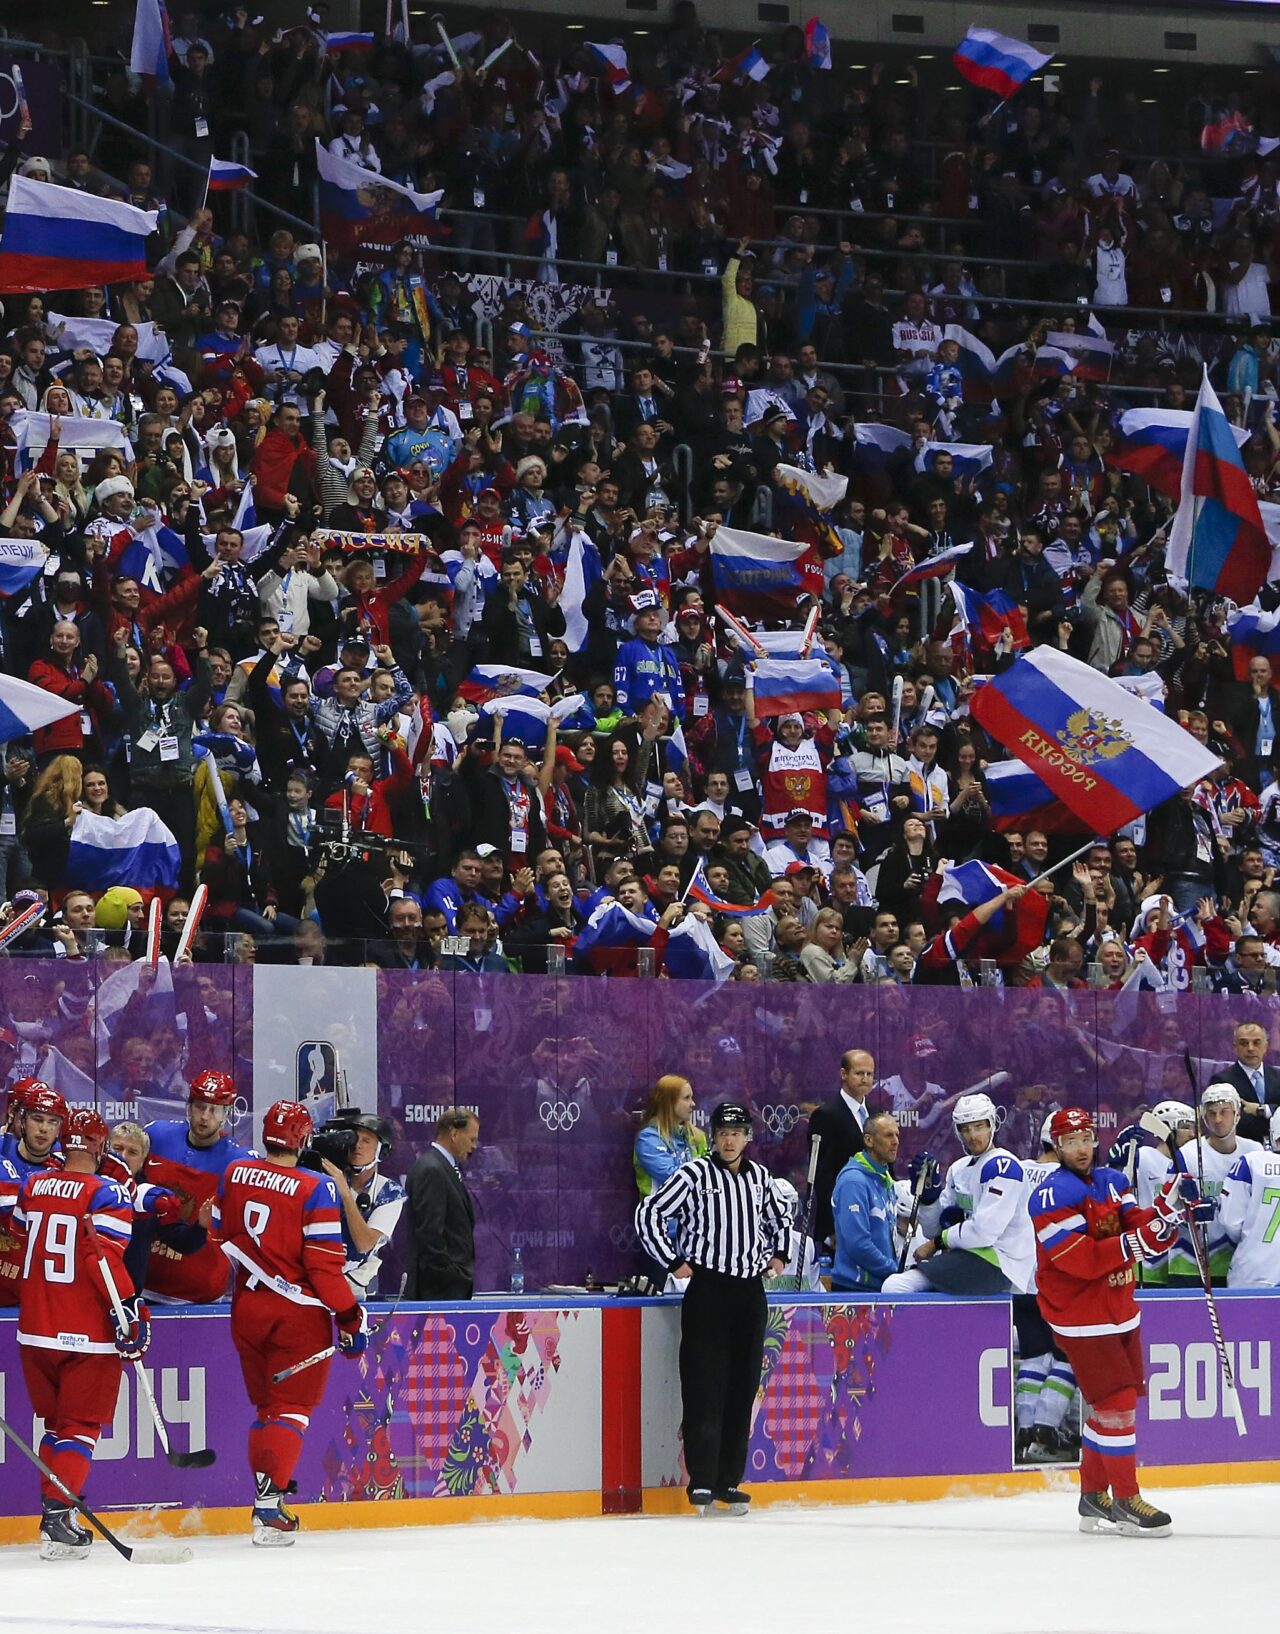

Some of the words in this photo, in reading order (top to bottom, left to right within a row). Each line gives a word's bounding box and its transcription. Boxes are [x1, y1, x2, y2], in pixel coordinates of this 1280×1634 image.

[900, 328, 936, 343] RUSSIA
[410, 441, 430, 457] СОЧИ
[317, 531, 421, 554] РОССИЯ
[481, 532, 504, 545] ССИЯ
[614, 666, 627, 682] 67
[105, 1101, 139, 1120] 2014
[892, 1110, 919, 1128] 2014
[1092, 1111, 1118, 1128] 2014
[71, 1135, 82, 1144] 79
[996, 1157, 1011, 1174] 17
[31, 1177, 85, 1200] MARKOV
[231, 1166, 301, 1197] OVECHKIN
[108, 1184, 132, 1205] 79
[326, 1182, 336, 1203] 8
[1038, 1187, 1055, 1209] 71
[1108, 1183, 1122, 1203] A
[23, 1211, 78, 1284] 79
[59, 1334, 86, 1343] sochi.ru
[1149, 1340, 1271, 1421] 2014
[32, 1366, 207, 1462] 014
